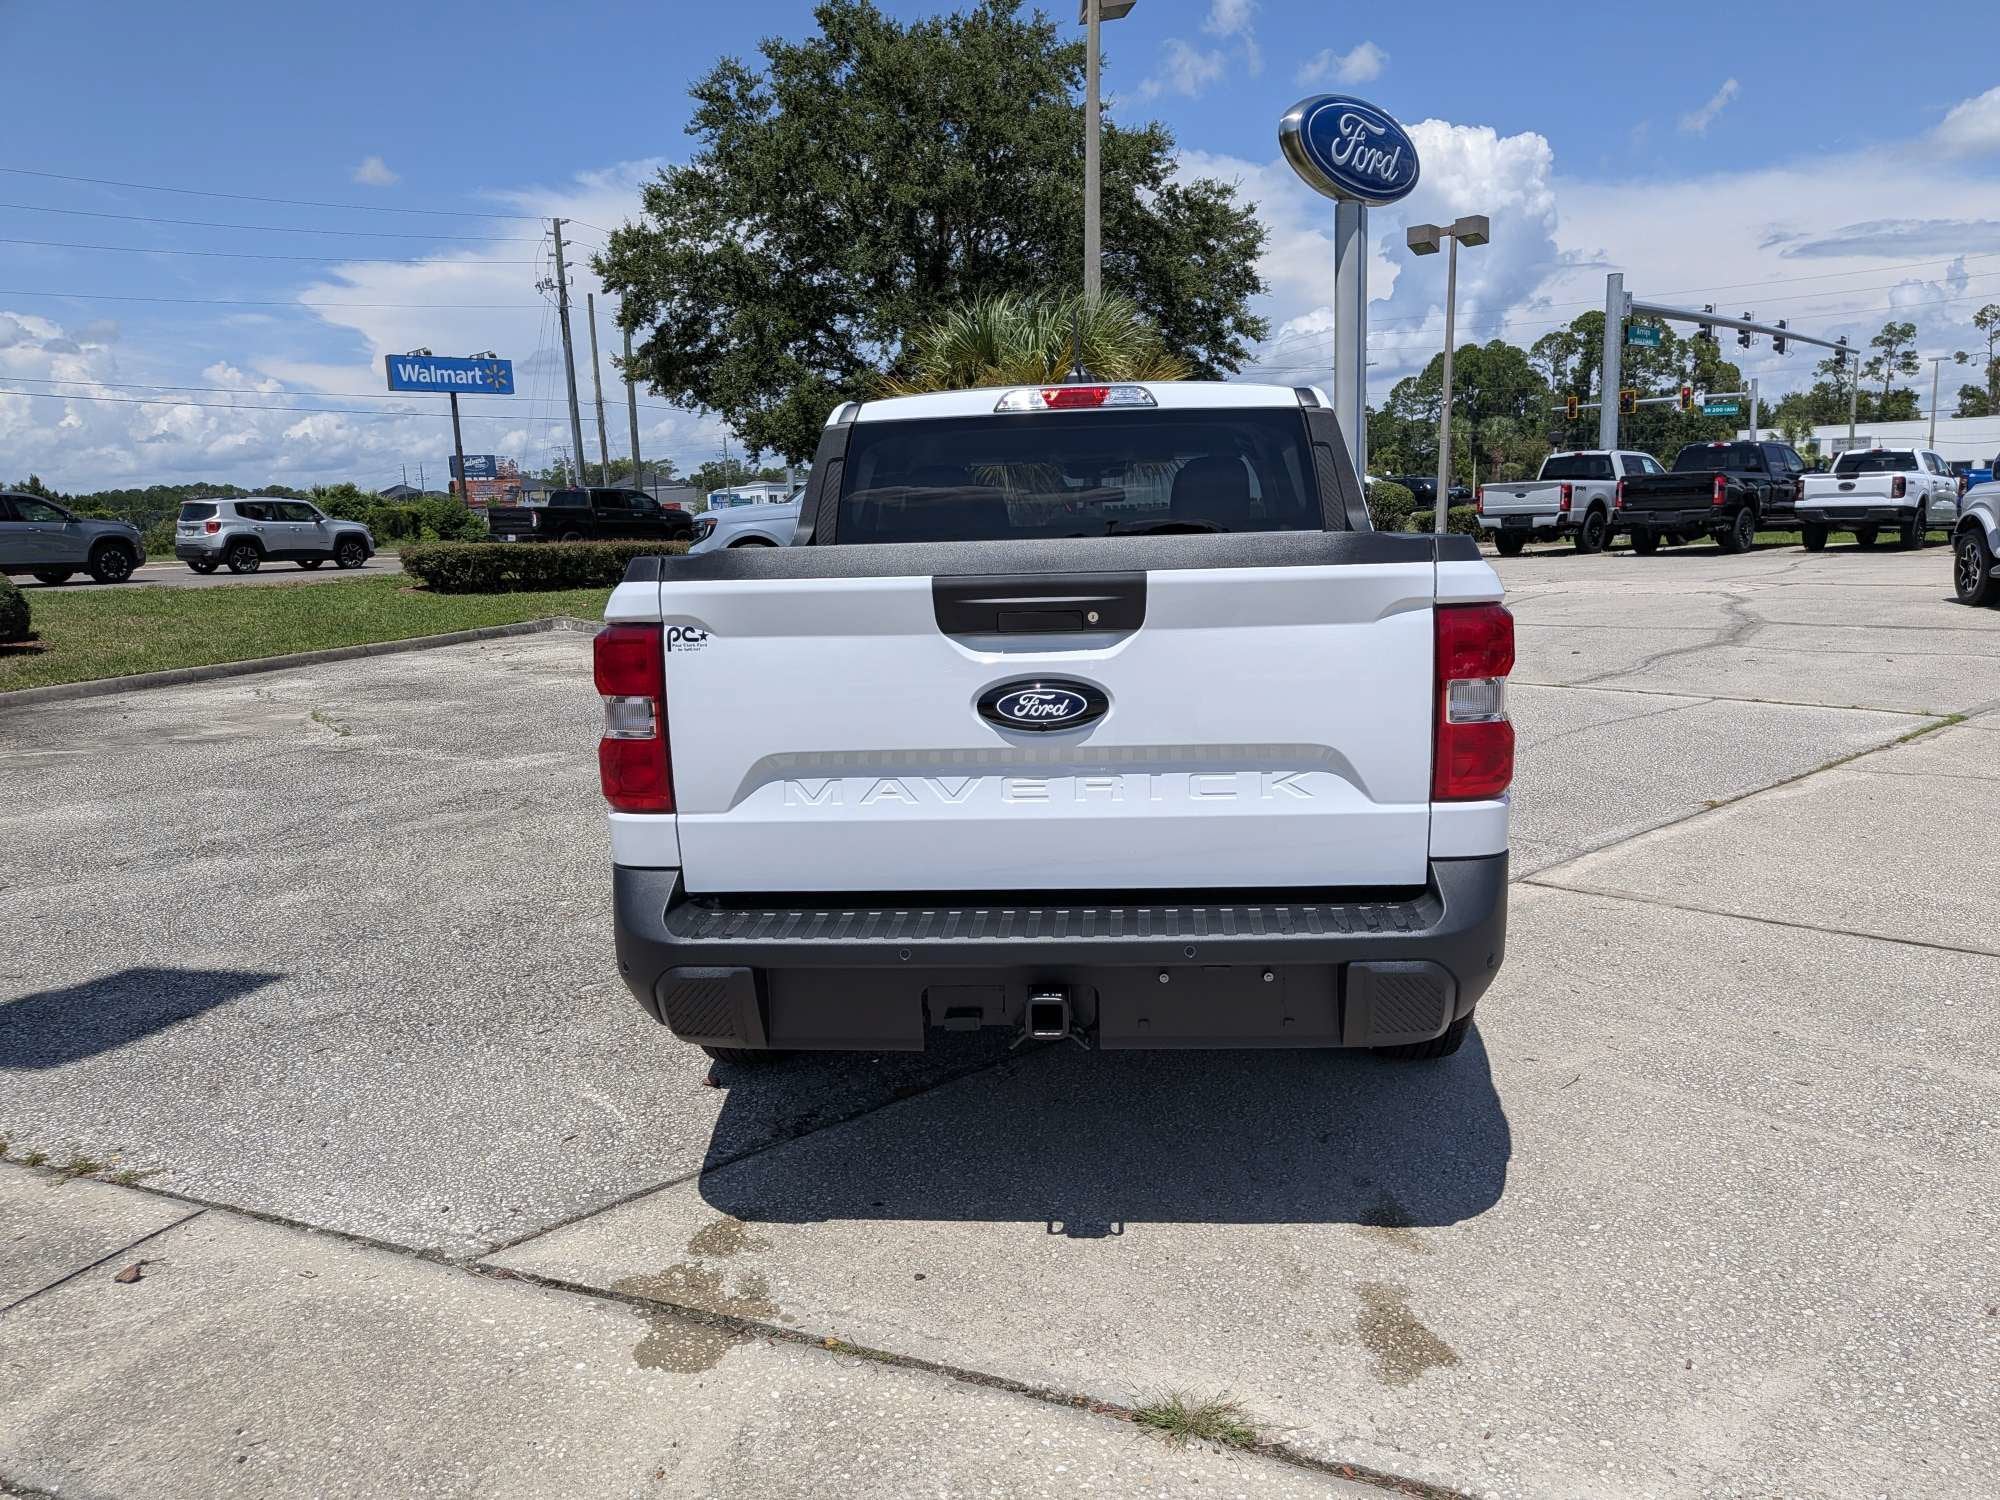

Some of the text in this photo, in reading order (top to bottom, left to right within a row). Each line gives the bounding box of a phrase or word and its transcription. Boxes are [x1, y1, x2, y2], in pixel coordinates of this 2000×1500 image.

[1331, 113, 1402, 182] Ford
[397, 363, 483, 385] Walmart
[1013, 693, 1069, 716] Ford
[783, 771, 1316, 806] MAVERICK
